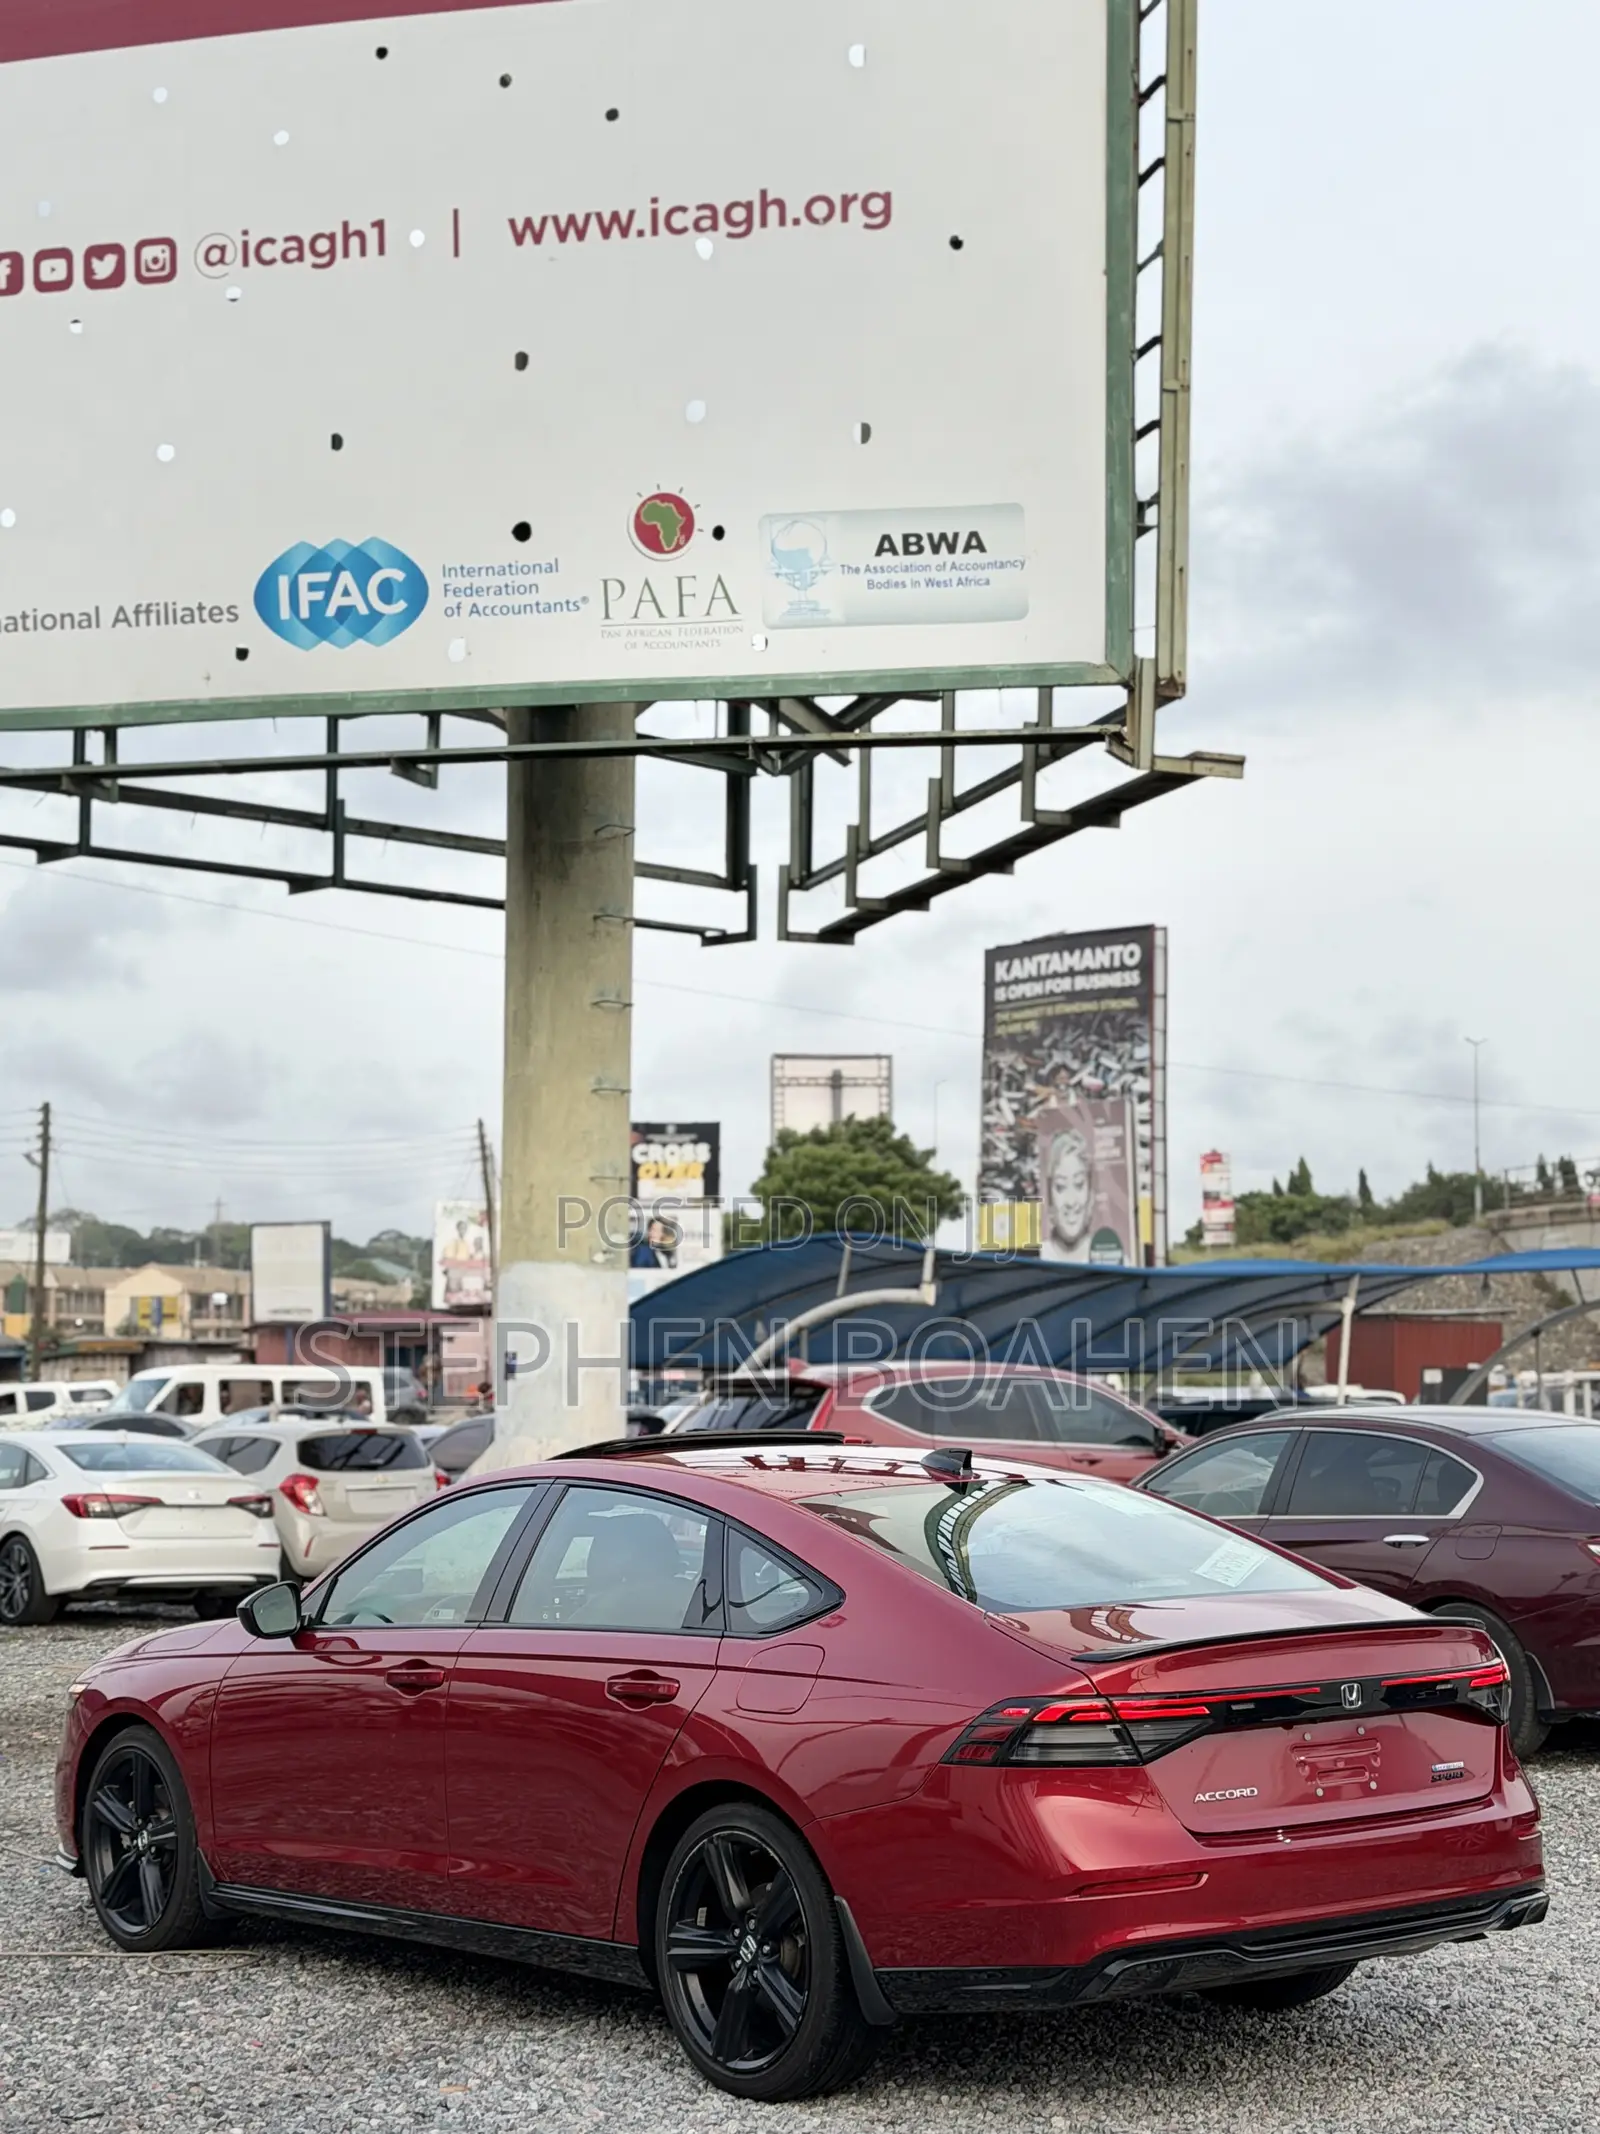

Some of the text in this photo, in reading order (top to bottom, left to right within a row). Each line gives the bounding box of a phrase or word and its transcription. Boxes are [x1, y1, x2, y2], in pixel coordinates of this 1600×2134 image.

[194, 188, 893, 279] @icagh1 www.icagh.org
[875, 531, 987, 557] ABWA
[442, 558, 559, 579] International
[840, 558, 1026, 575] The Association of Accountancy
[278, 568, 408, 621] IFAC
[443, 581, 539, 598] Federation
[867, 578, 907, 591] Bodies
[924, 576, 953, 588] West
[956, 575, 990, 588] Africa
[444, 601, 462, 618] of
[600, 573, 742, 620] PAFA
[0, 601, 240, 633] ational Affiliates
[994, 942, 1142, 983] KANTAMANTO
[1008, 980, 1044, 1001] OPEN
[1045, 976, 1073, 994] FOR
[1074, 970, 1141, 991] BUSINESS
[1193, 1786, 1259, 1803] ACCORD
